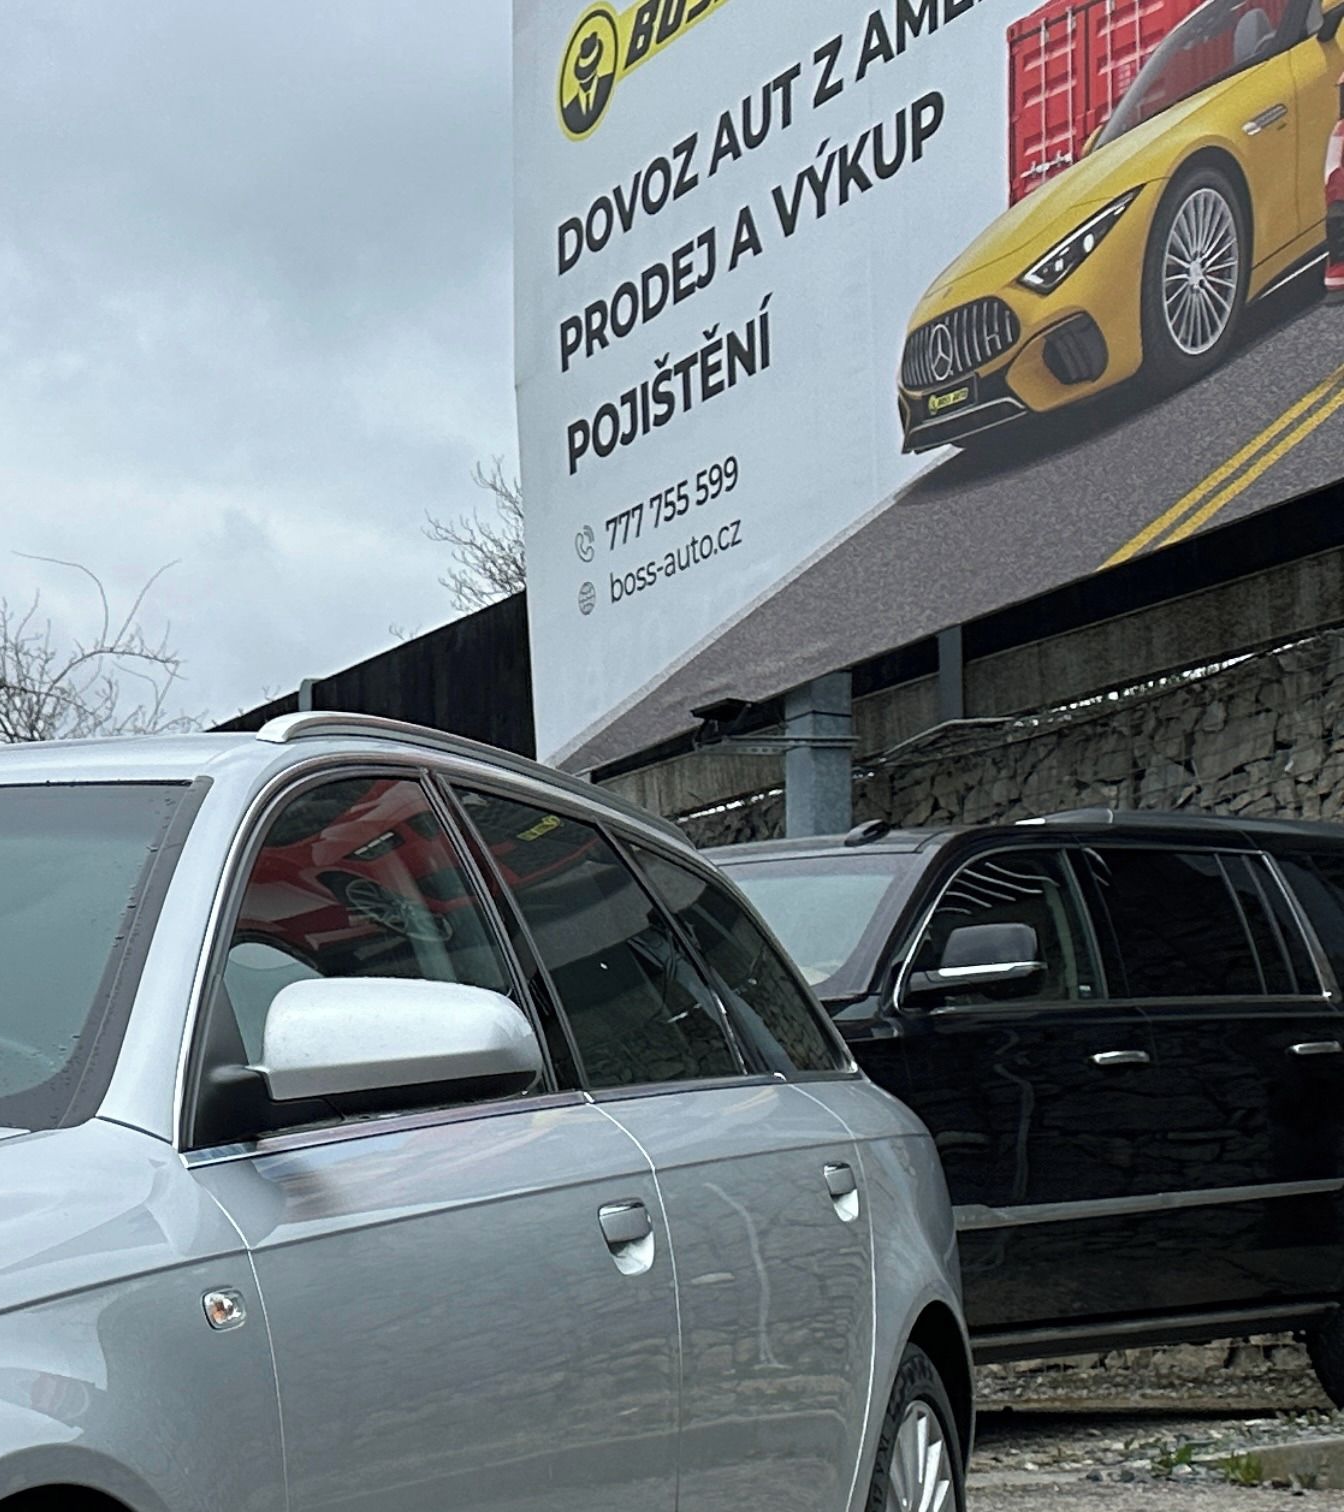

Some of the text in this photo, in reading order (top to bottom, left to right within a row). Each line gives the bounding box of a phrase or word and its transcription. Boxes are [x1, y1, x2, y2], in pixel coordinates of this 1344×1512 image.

[557, 0, 984, 276] DOVOZ AUT Z AM
[559, 90, 945, 374] PRODEJ A VÝKUP
[566, 291, 774, 477] POJIŠTĚNÍ
[605, 455, 739, 551] 777 755 599
[609, 518, 743, 604] boss-auto.cz
